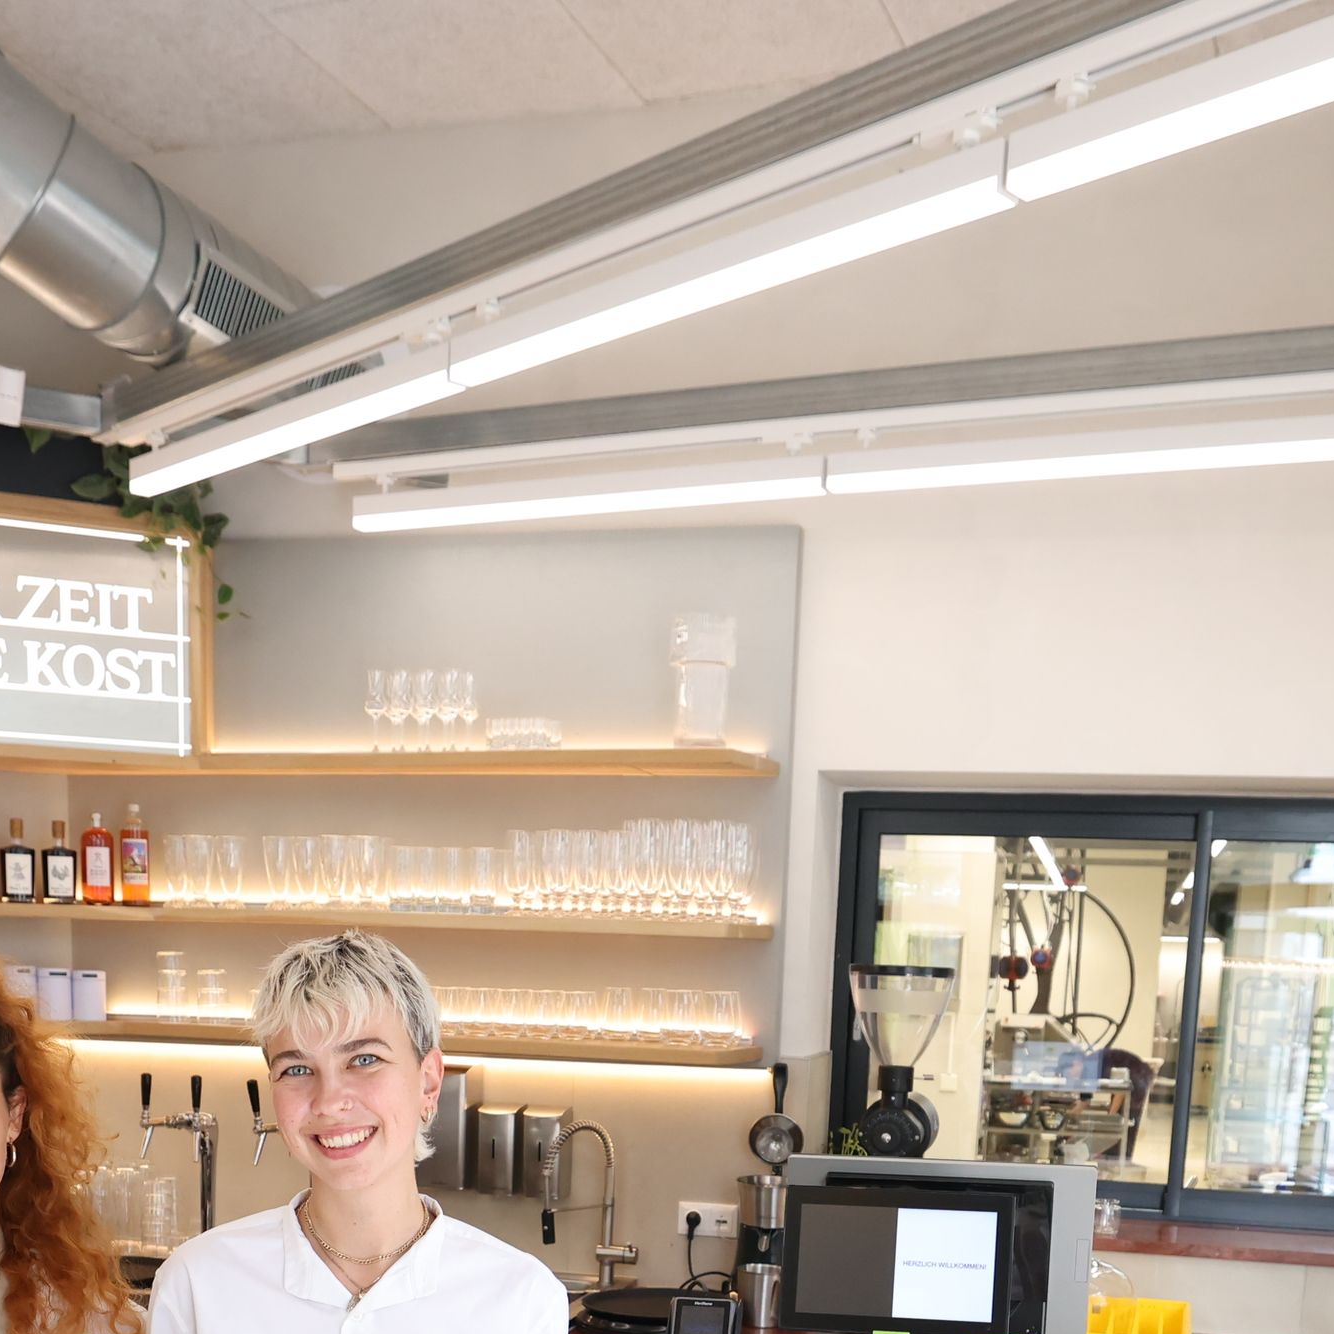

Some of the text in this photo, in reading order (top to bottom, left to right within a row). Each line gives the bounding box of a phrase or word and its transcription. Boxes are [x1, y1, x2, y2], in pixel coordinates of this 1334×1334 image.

[17, 574, 153, 632] ZEIT
[23, 640, 178, 697] KOST
[903, 1260, 986, 1270] HERZLICH WILLKOMMEN!
